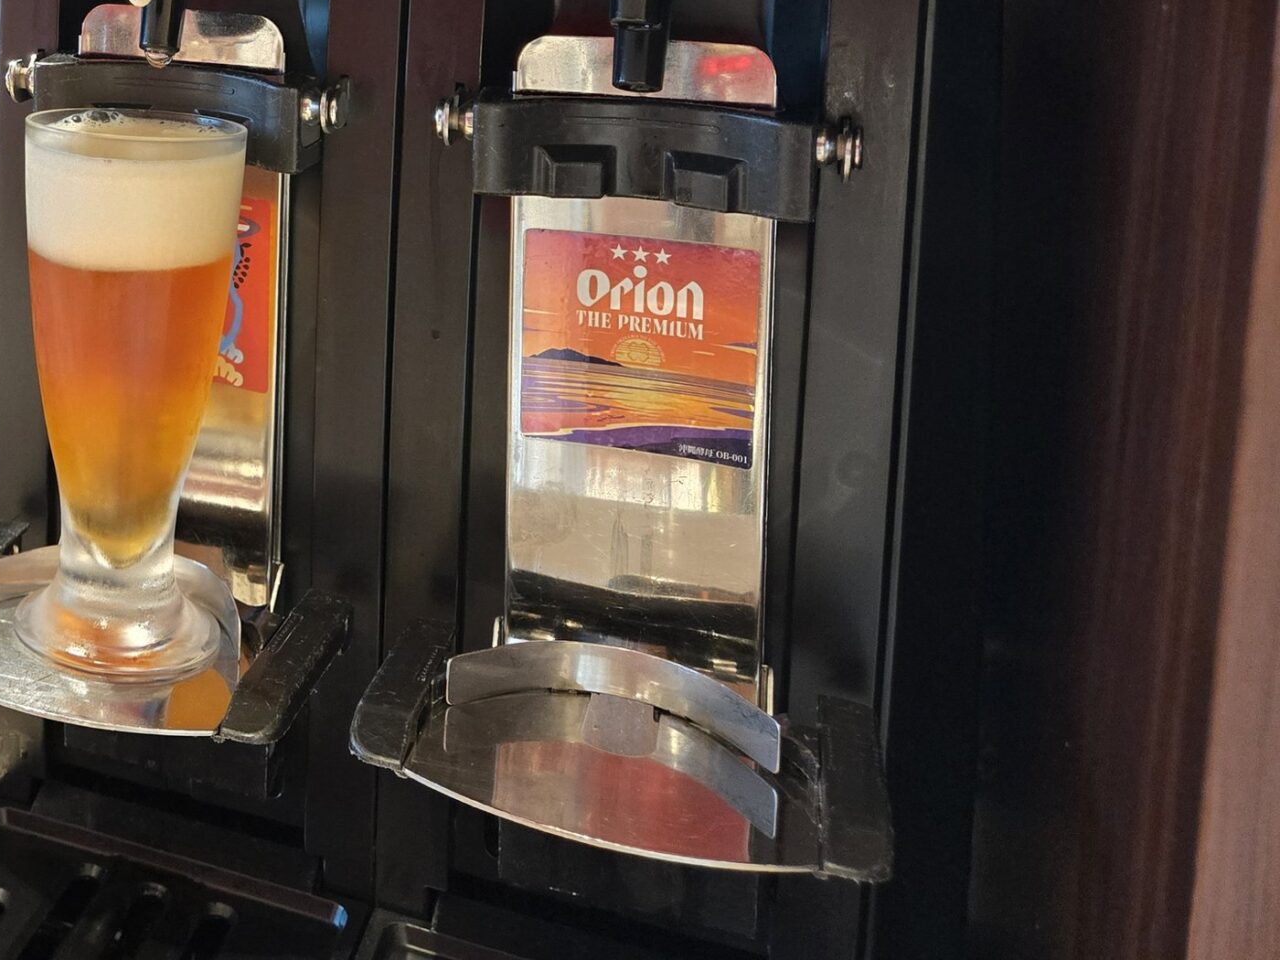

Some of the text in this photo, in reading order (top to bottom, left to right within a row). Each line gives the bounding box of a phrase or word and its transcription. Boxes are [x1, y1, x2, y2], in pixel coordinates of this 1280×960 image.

[576, 265, 704, 321] Orion
[576, 309, 704, 341] THE PREMIUM
[716, 450, 747, 464] OB-001
